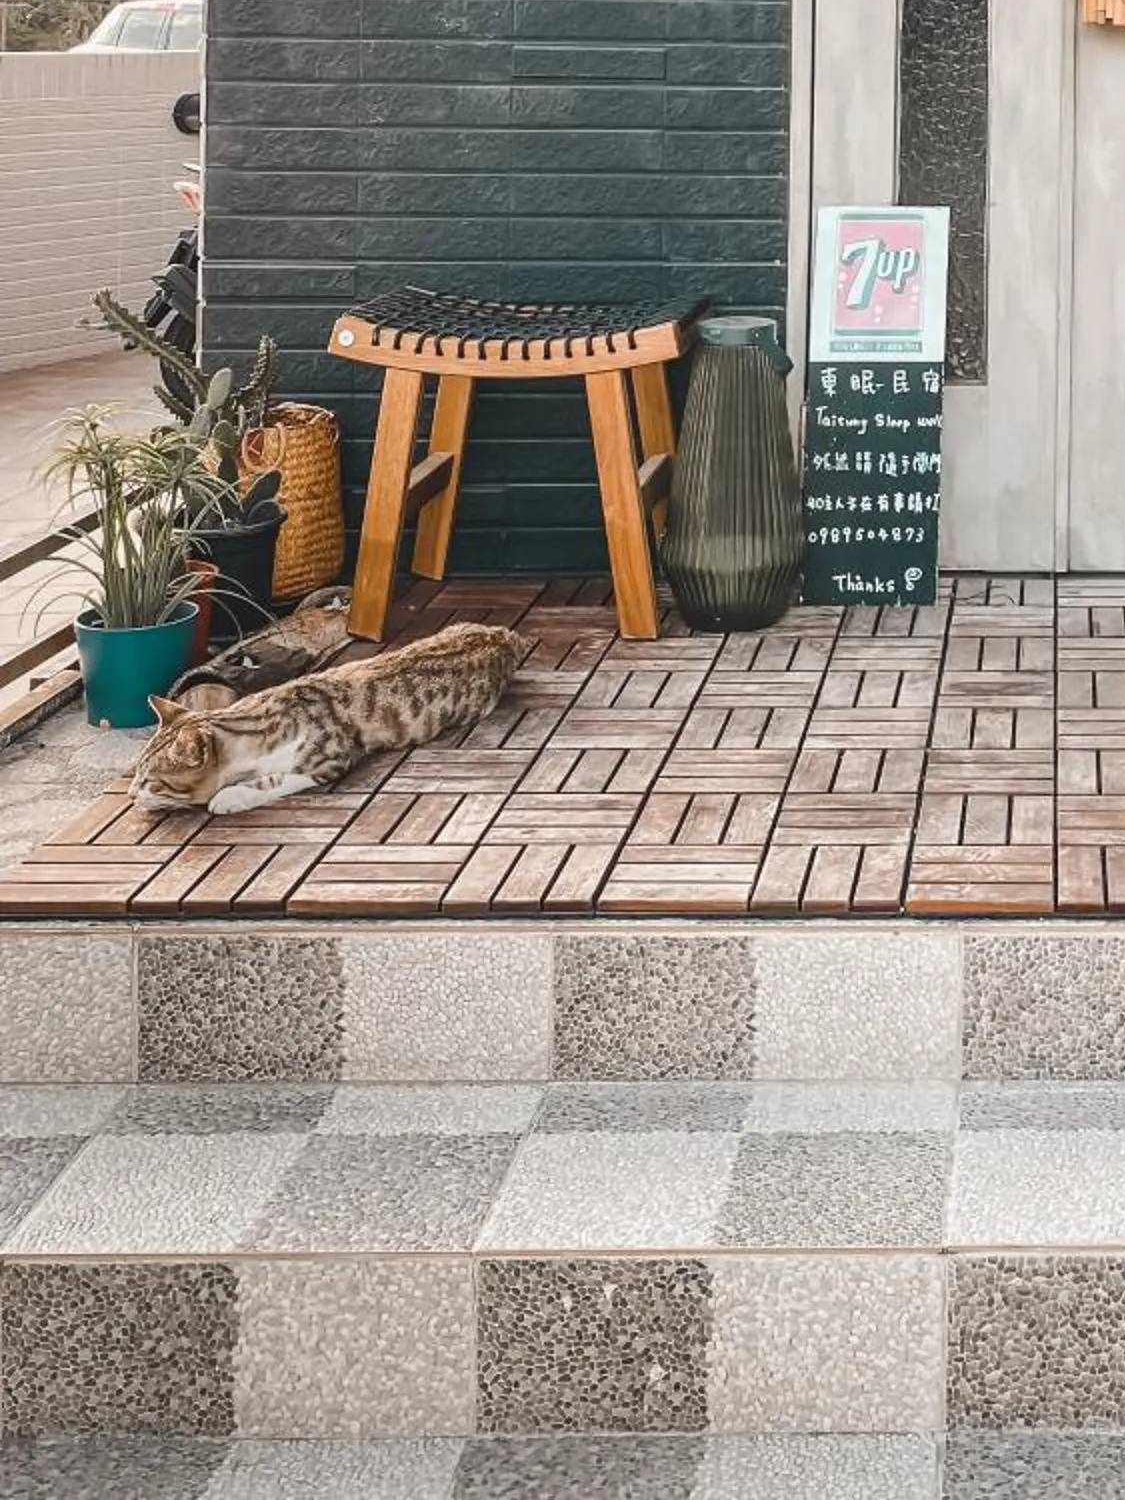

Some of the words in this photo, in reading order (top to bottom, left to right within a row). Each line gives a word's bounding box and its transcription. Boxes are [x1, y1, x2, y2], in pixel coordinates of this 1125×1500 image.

[815, 405, 868, 435] Taitung
[874, 412, 911, 433] Sleep
[832, 572, 895, 593] Thanks
